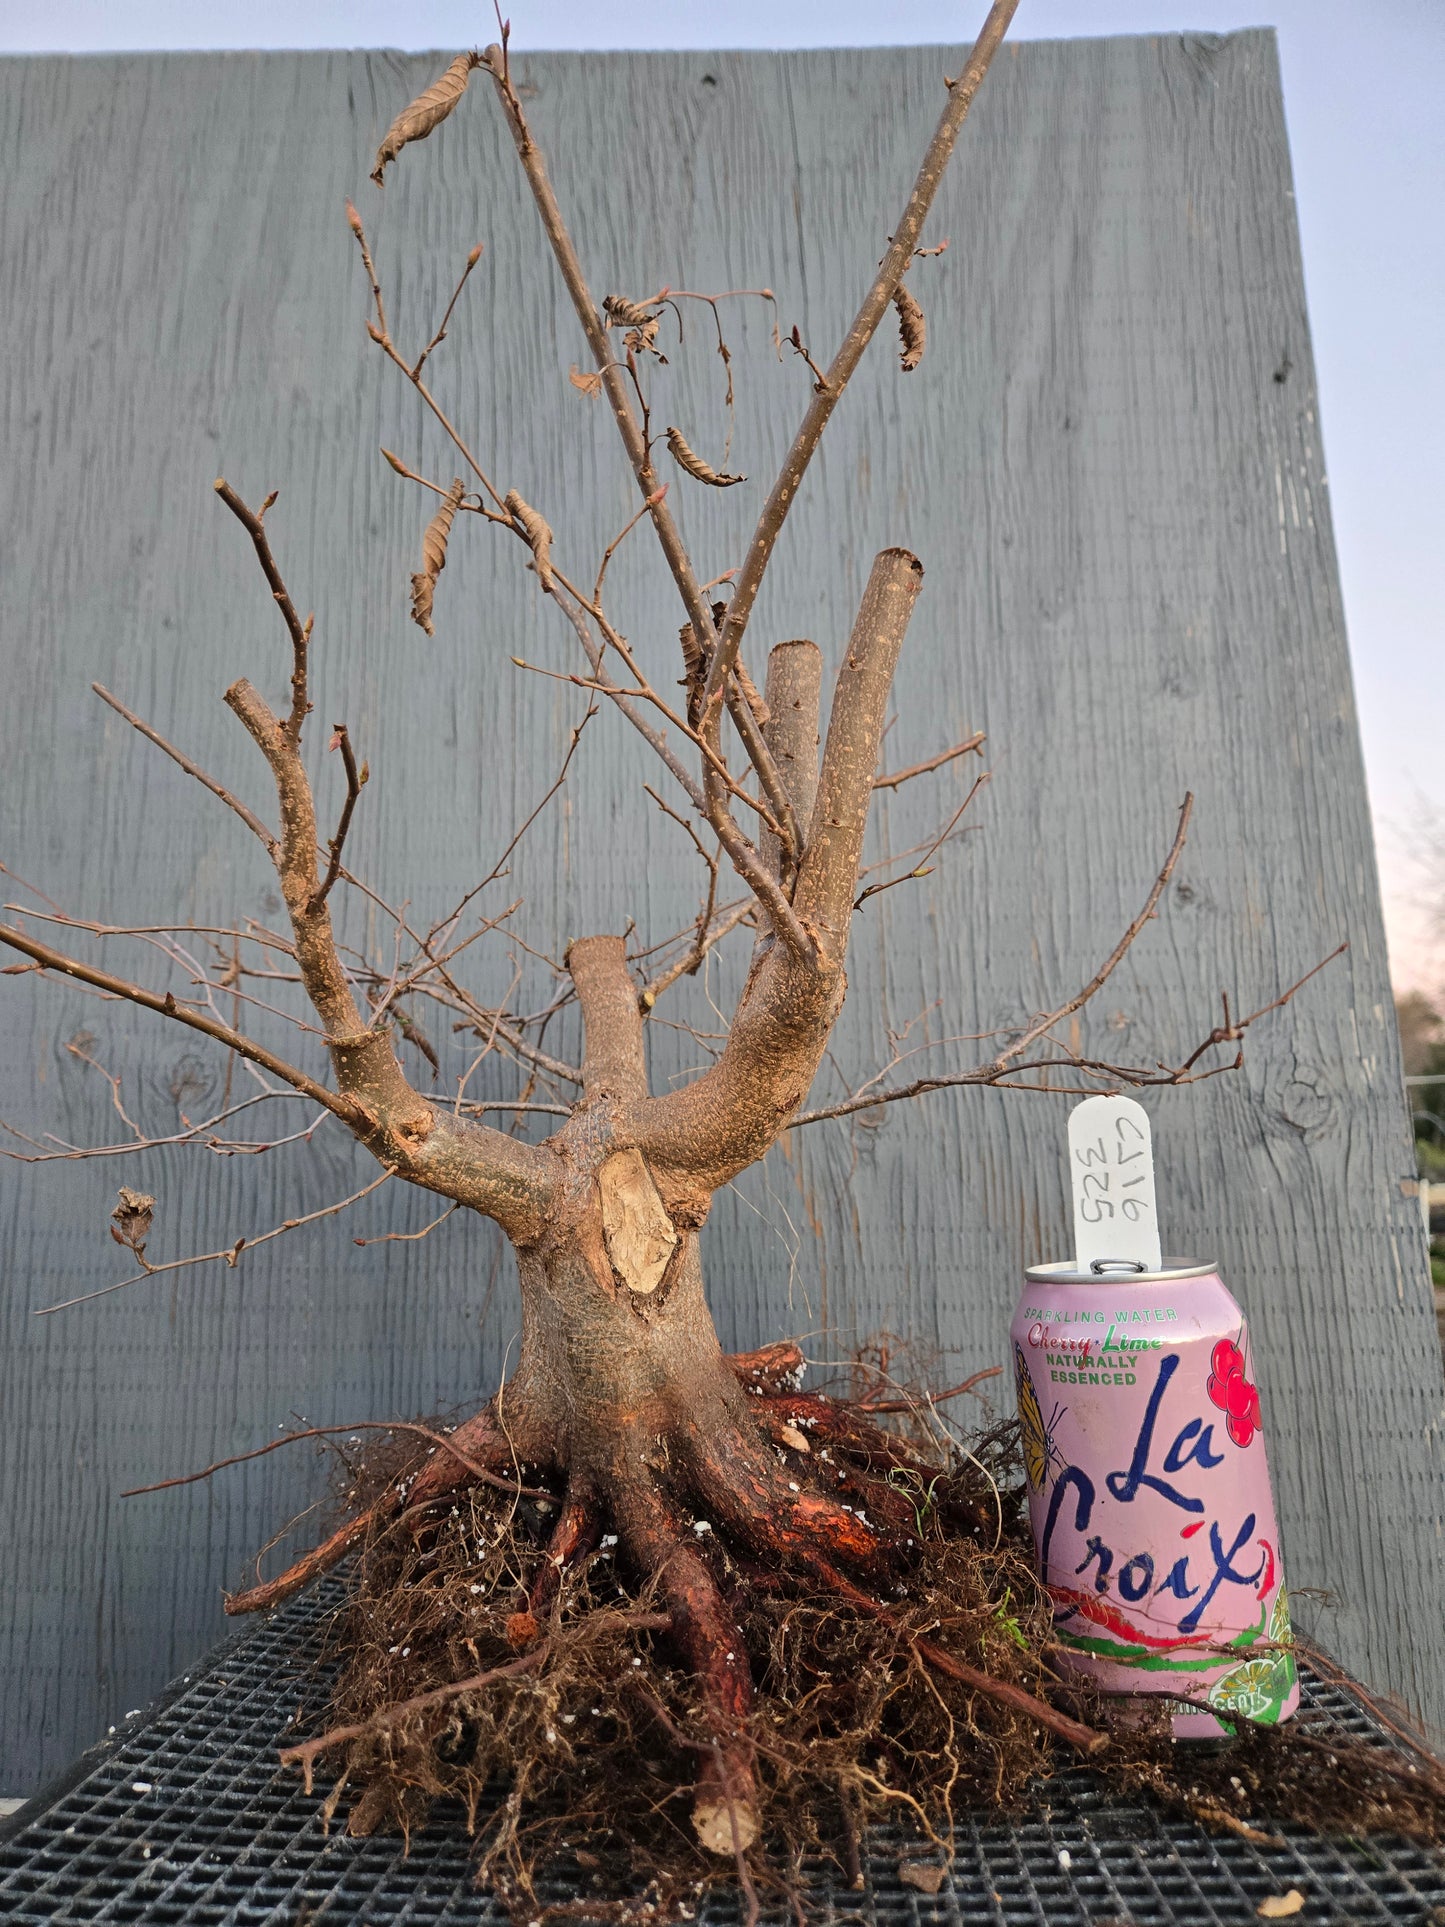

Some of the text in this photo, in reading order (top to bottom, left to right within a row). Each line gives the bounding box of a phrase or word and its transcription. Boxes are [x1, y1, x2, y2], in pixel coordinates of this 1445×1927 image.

[1075, 1137, 1114, 1223] 325
[1023, 1306, 1179, 1324] SPARKLING WATER
[1027, 1322, 1163, 1370] Cherry Lime
[1046, 1353, 1138, 1370] NATURALLY
[1051, 1371, 1137, 1386] ESSENCED
[1105, 1354, 1225, 1514] La
